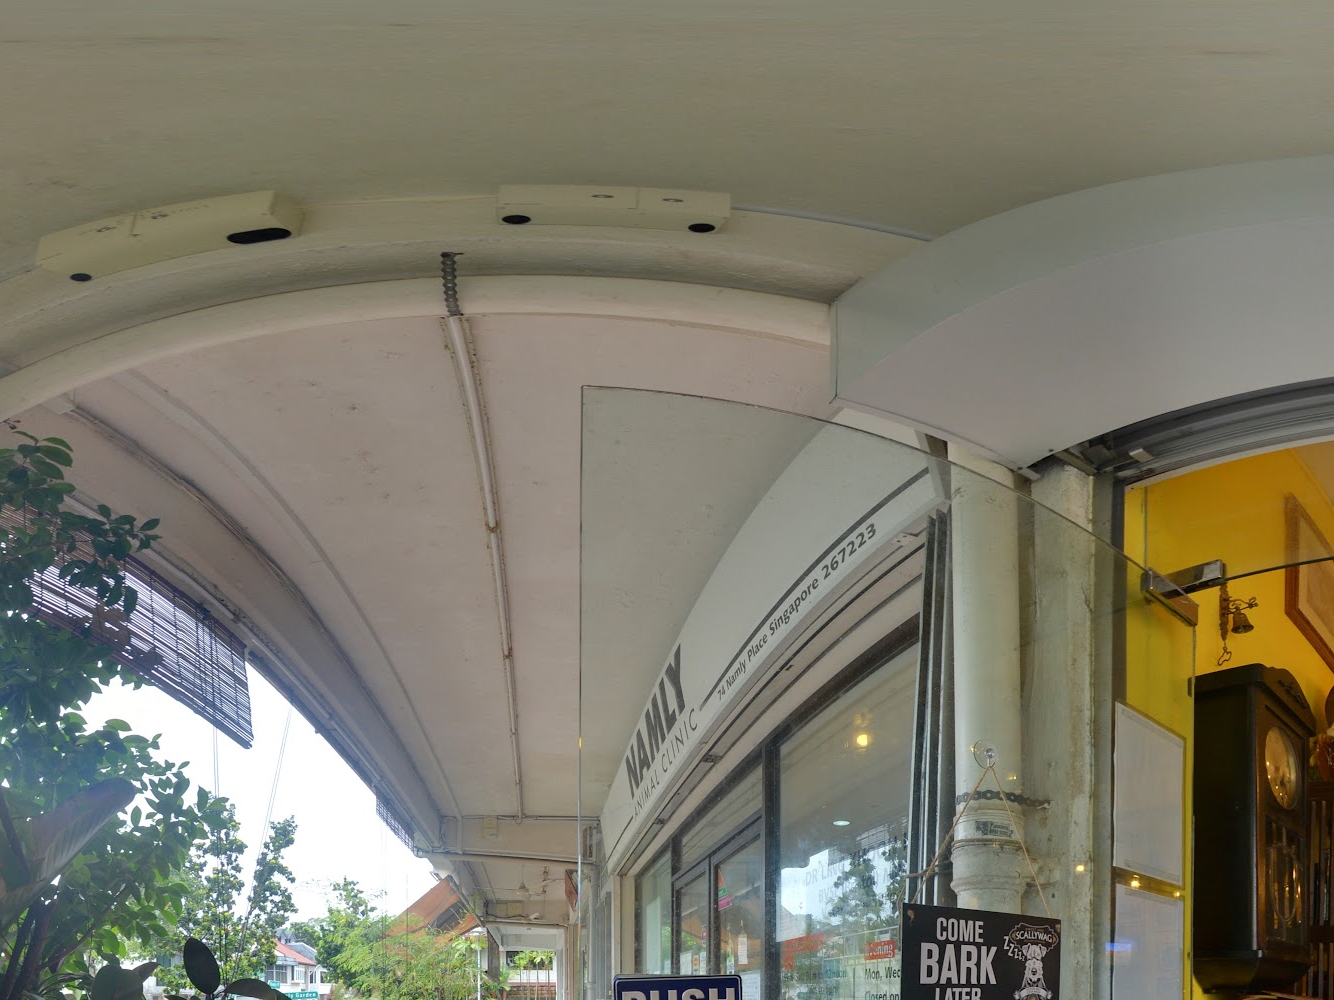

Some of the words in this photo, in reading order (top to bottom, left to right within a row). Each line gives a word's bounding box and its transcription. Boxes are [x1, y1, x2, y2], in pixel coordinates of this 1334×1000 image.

[717, 684, 726, 701] 74
[726, 658, 746, 690] Namly
[747, 633, 768, 662] Place
[769, 578, 819, 636] Singapore
[821, 523, 877, 580] 267223
[625, 643, 686, 801] NAMLY
[633, 771, 660, 821] ANIMAL
[661, 708, 698, 773] CLINIC
[919, 942, 998, 985] BARK
[936, 917, 984, 943] COME
[1015, 930, 1053, 943] SCALLYWAG
